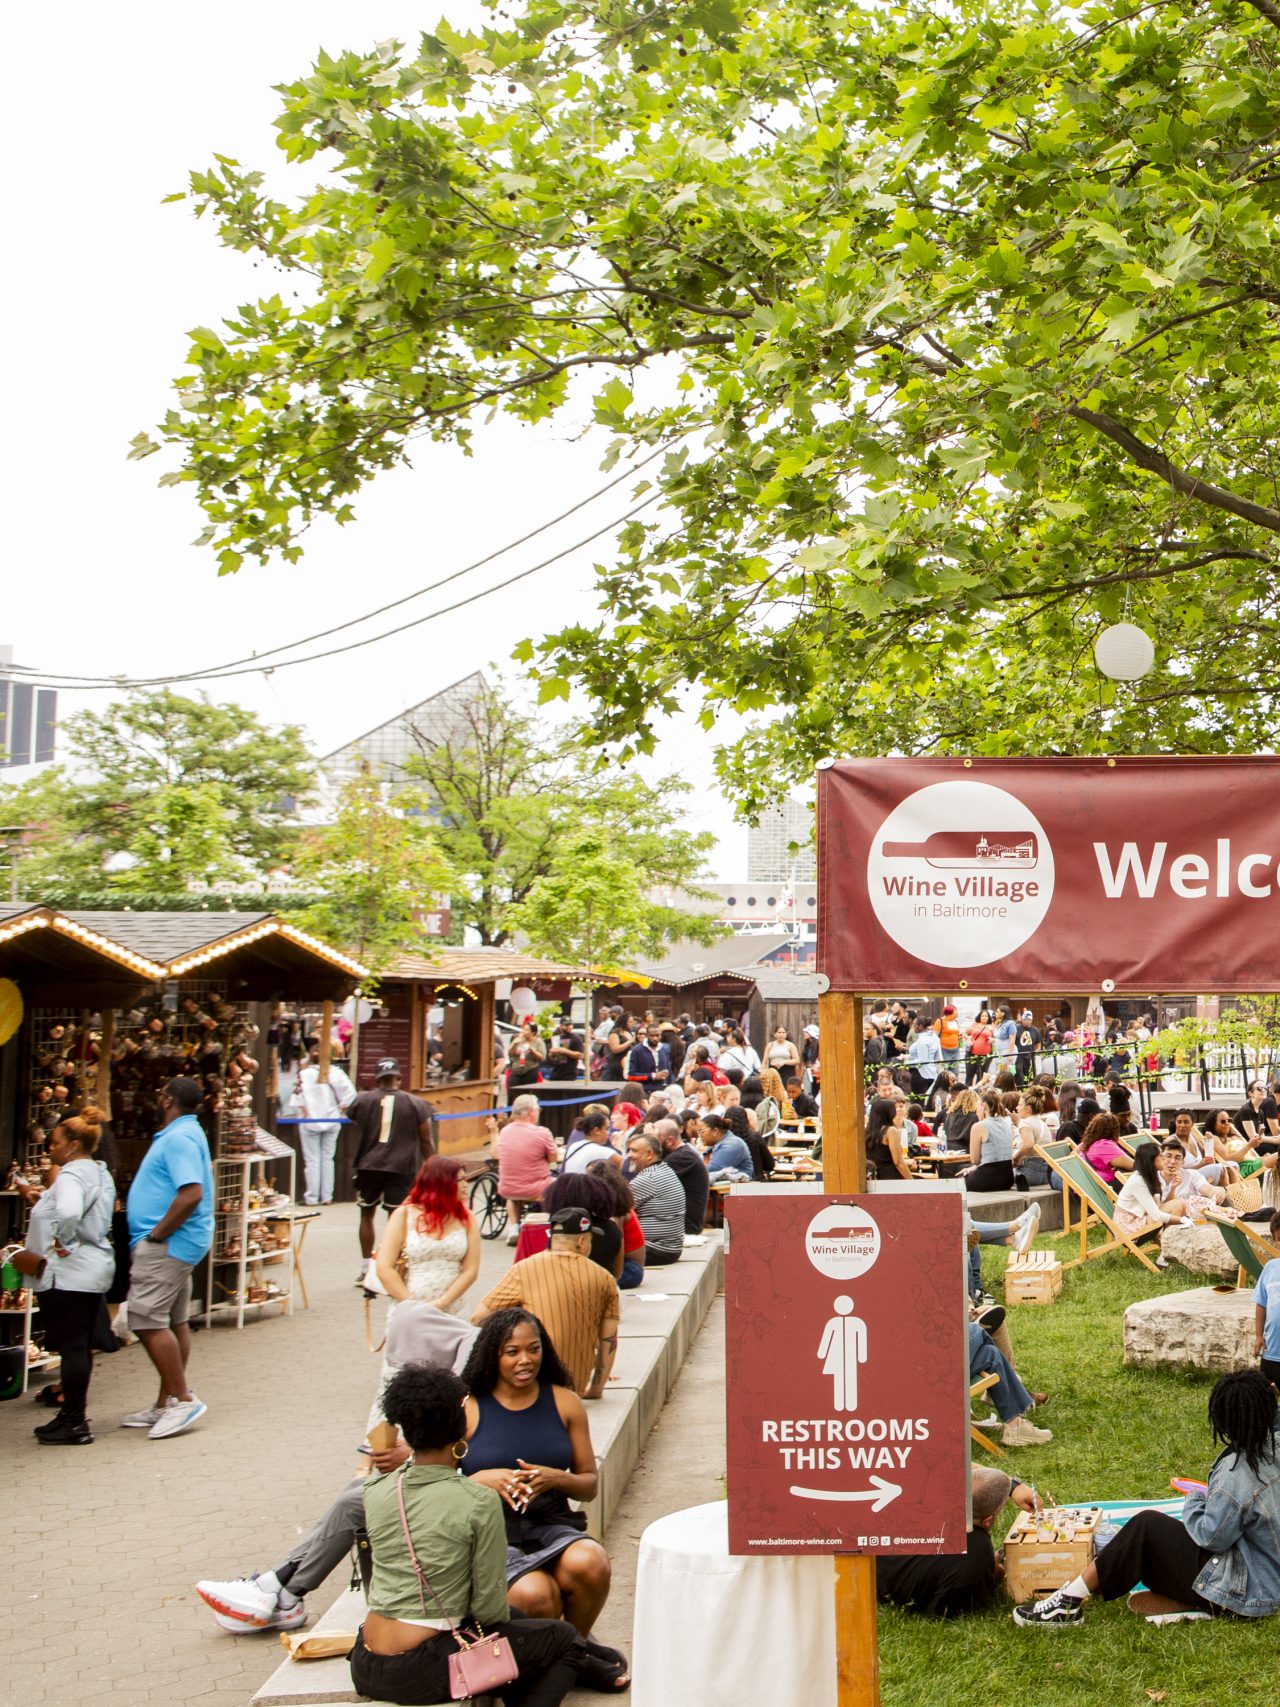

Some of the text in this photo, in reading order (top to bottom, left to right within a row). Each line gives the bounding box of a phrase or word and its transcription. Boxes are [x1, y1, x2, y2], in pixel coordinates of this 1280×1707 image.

[882, 876, 1039, 903] Wine Village
[913, 903, 1007, 917] in Baltimore
[377, 1095, 395, 1143] 1
[812, 1245, 875, 1255] Wine Village
[762, 1418, 930, 1442] RESTROOMS
[779, 1446, 912, 1470] THIS WAY
[748, 1536, 945, 1546] www.baltimore-wine.com @bmore.wine
